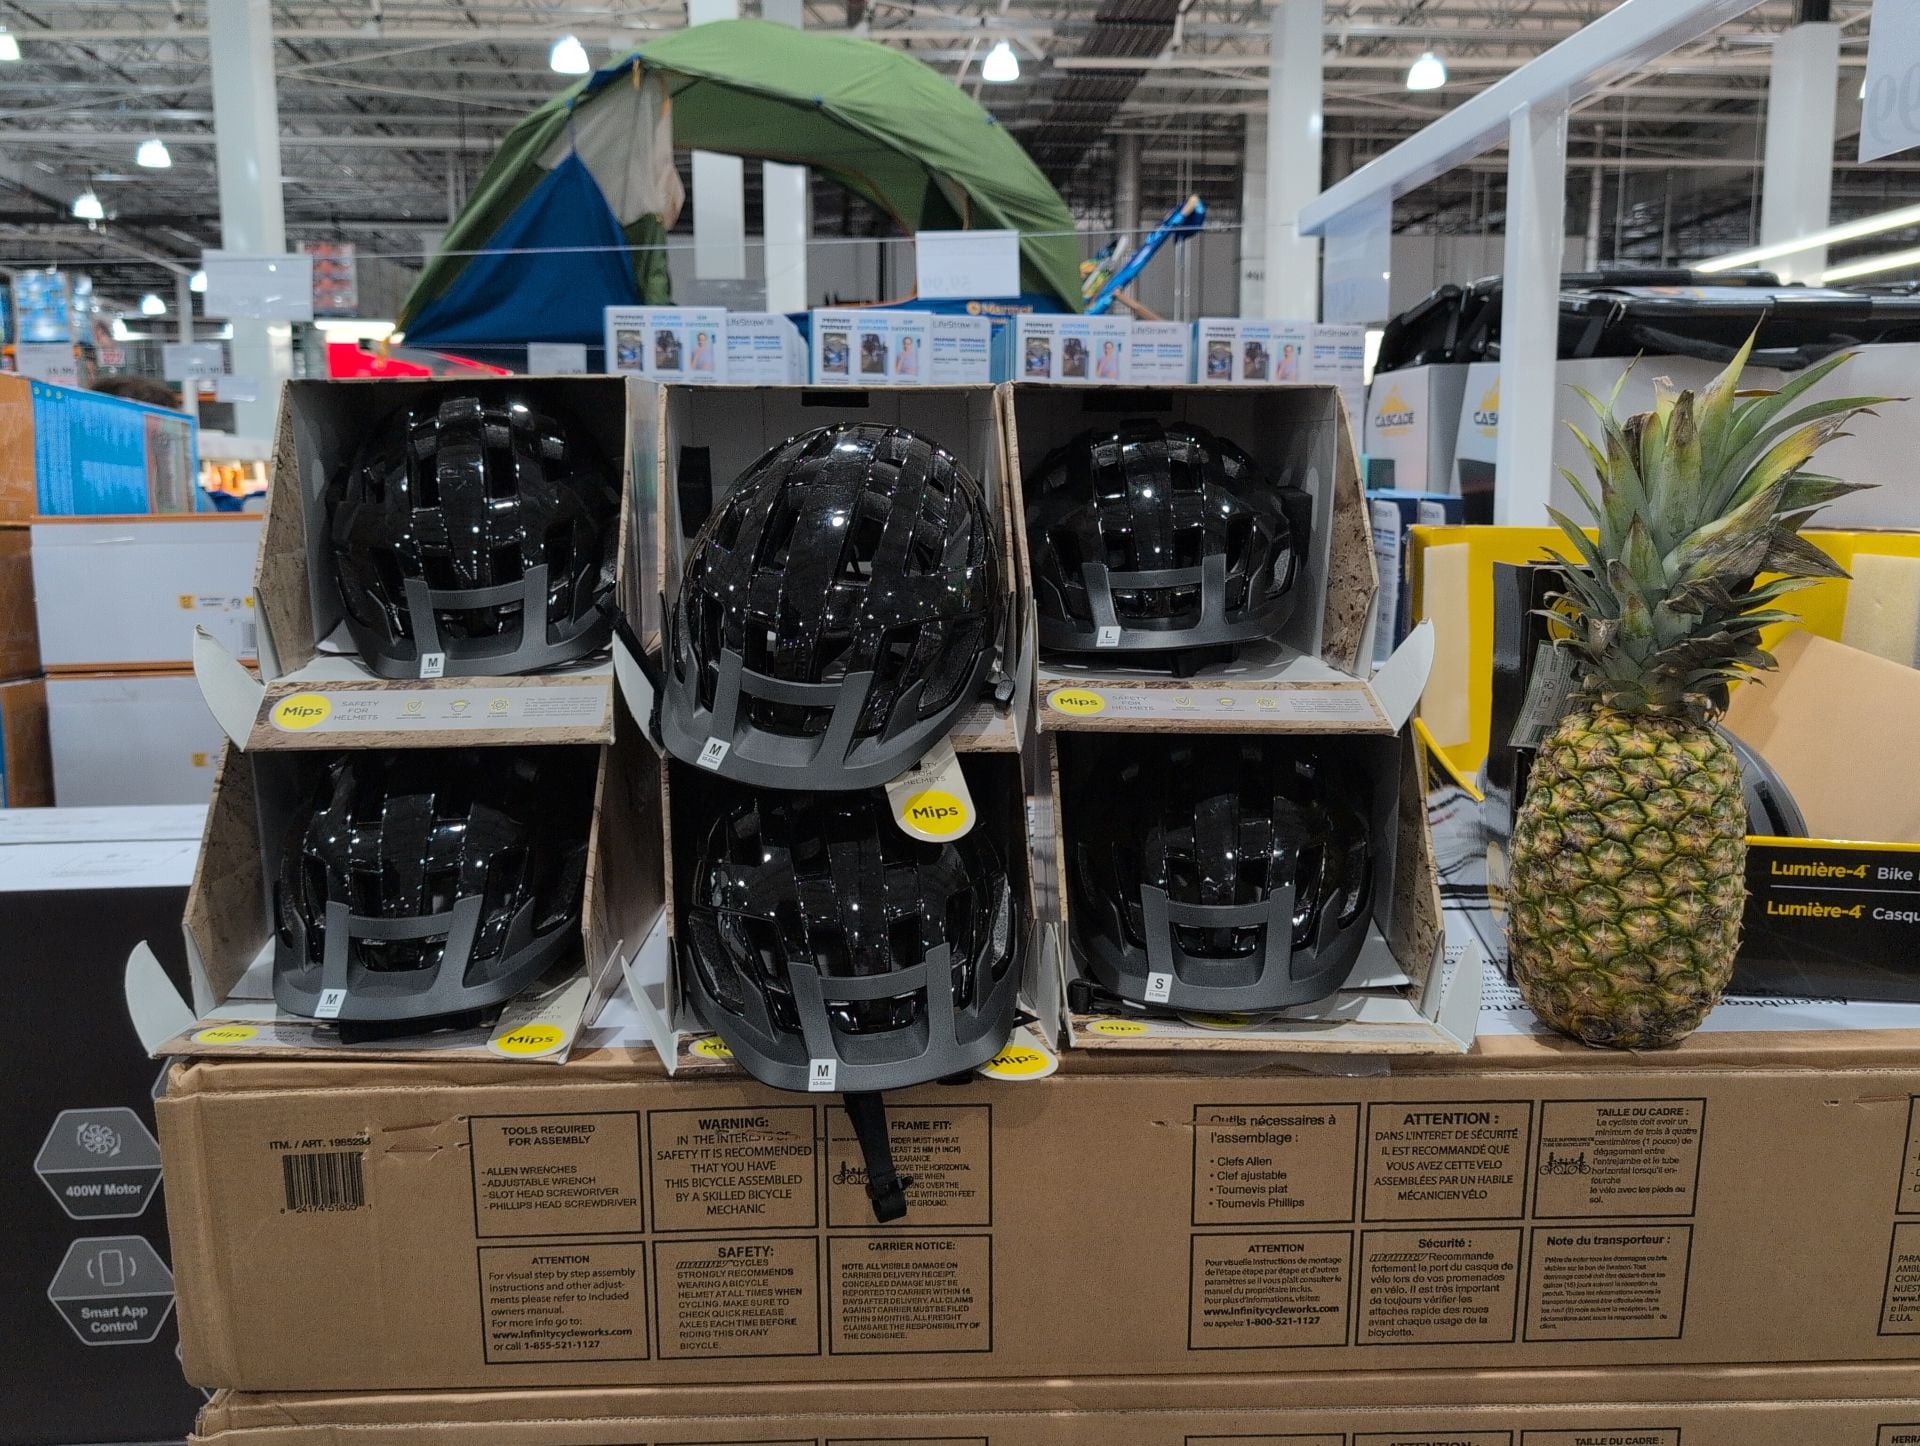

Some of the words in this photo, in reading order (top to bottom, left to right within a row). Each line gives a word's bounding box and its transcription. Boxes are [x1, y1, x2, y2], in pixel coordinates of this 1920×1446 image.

[1375, 413, 1414, 427] CASCADE
[1474, 412, 1498, 425] CAS
[1105, 630, 1112, 638] L
[428, 658, 438, 668] M
[1060, 698, 1098, 706] Mips
[283, 707, 323, 717] Mips
[708, 744, 722, 756] M
[904, 776, 946, 785] HELMETS
[913, 806, 958, 819] Mips
[1878, 867, 1913, 881] Bike
[1154, 978, 1164, 989] S
[326, 994, 338, 1004] M
[507, 1036, 554, 1044] Mips
[992, 1055, 1039, 1066] Mips
[817, 1064, 829, 1077] M
[1649, 1108, 1683, 1116] CADRE
[699, 1117, 769, 1129] WARNING:
[1251, 1115, 1324, 1126] nécessaires
[1329, 1114, 1336, 1125] à
[1404, 1113, 1490, 1125] ATTENTION
[502, 1127, 537, 1135] TOOLS
[541, 1125, 595, 1133] REQUIRED
[891, 1121, 930, 1130] FRAME
[933, 1121, 951, 1130] FIT:
[1211, 1133, 1292, 1145] l'assemblage
[1375, 1132, 1403, 1140] DANS
[1406, 1131, 1451, 1140] L'INTERET
[1455, 1131, 1469, 1139] DE
[1471, 1128, 1519, 1139] SÉCURITÉ
[270, 1141, 291, 1149] ITM.
[302, 1139, 326, 1148] ART.
[509, 1138, 531, 1146] FOR
[534, 1136, 590, 1144] ASSEMBLY
[677, 1136, 688, 1145] IN
[693, 1135, 715, 1144] THE
[657, 1150, 697, 1160] SAFETY
[701, 1149, 711, 1159] IT
[714, 1149, 722, 1158] IS
[725, 1146, 812, 1157] RECOMMENDED
[1382, 1147, 1390, 1155] IL
[1392, 1147, 1410, 1155] EST
[1412, 1144, 1486, 1155] RECOMMANDÉ
[1488, 1145, 1509, 1155] QUE
[1218, 1157, 1244, 1166] Clefs
[1246, 1157, 1272, 1165] Allen
[1387, 1162, 1414, 1170] VOUS
[1417, 1162, 1442, 1170] AVEZ
[1445, 1161, 1475, 1170] CETTE
[1478, 1161, 1502, 1169] VELO
[519, 1166, 577, 1174] WRENCHES
[691, 1164, 719, 1173] THAT
[722, 1163, 743, 1172] YOU
[748, 1161, 776, 1171] HAVE
[552, 1177, 595, 1185] WRENCH
[666, 1179, 688, 1188] THIS
[692, 1177, 735, 1187] BICYCLE
[738, 1175, 802, 1186] ASSEMBLED
[1217, 1171, 1239, 1180] Clef
[1241, 1171, 1287, 1182] ajustable
[1374, 1176, 1437, 1185] ASSEMBLÉES
[1439, 1176, 1458, 1185] PAR
[1461, 1176, 1476, 1184] UN
[1478, 1175, 1513, 1184] HABILE
[66, 1185, 101, 1197] 400W
[105, 1184, 142, 1195] Motor
[517, 1190, 543, 1198] HEAD
[547, 1188, 619, 1197] SCREWDRIVER
[1269, 1185, 1287, 1195] plat
[1398, 1190, 1460, 1200] MÉCANICIEN
[1462, 1189, 1487, 1199] VÉLO
[676, 1193, 689, 1202] BY
[692, 1193, 700, 1201] A
[703, 1191, 745, 1200] SKILLED
[749, 1190, 791, 1199] BICYCLE
[565, 1199, 637, 1207] SCREWDRIVER
[1269, 1198, 1304, 1208] Phillips
[706, 1204, 765, 1215] MECHANIC
[1547, 1236, 1573, 1246] Note
[1577, 1236, 1591, 1246] du
[1594, 1235, 1664, 1246] transporteur
[868, 1243, 913, 1251] CARRIER
[916, 1242, 955, 1250] NOTICE:
[1248, 1244, 1304, 1253] ATTENTION
[718, 1246, 774, 1258] SAFETY:
[532, 1256, 590, 1264] ATTENTION
[489, 1272, 504, 1280] For
[535, 1271, 554, 1279] step
[557, 1270, 568, 1279] by
[571, 1270, 590, 1278] step
[593, 1268, 635, 1278] assembly
[728, 1269, 793, 1277] RECOMMENDS
[82, 1308, 118, 1318] Smart
[122, 1306, 148, 1317] App
[91, 1320, 137, 1333] Control
[1246, 1317, 1320, 1326] 1-800-521-1127
[525, 1340, 600, 1350] 1-855-521-1127
[1575, 1438, 1607, 1446] TAILLE
[1626, 1437, 1660, 1445] CADRE
